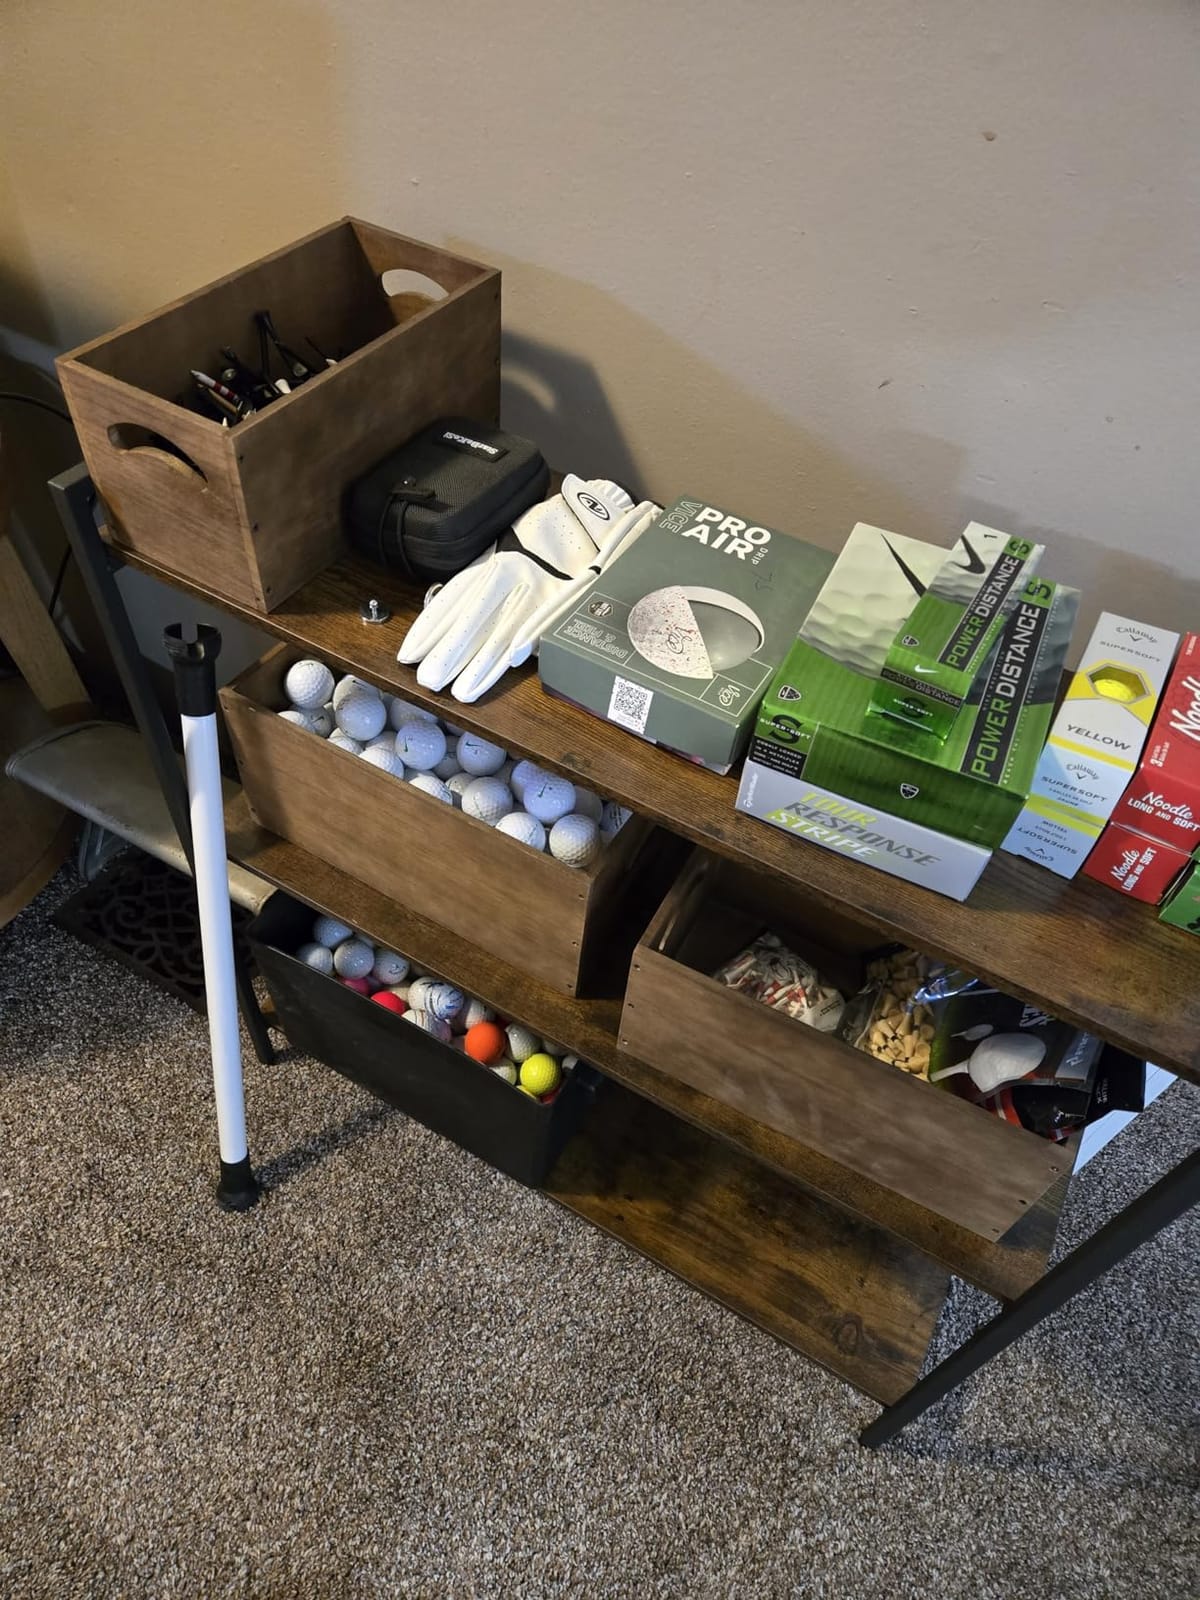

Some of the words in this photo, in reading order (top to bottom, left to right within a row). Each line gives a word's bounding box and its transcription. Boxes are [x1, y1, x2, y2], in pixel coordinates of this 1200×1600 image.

[659, 501, 702, 533] VICE
[695, 507, 771, 545] PRO
[681, 524, 754, 560] AIR
[946, 615, 984, 667] POWER
[974, 556, 1020, 617] DISTANCE
[1100, 641, 1160, 662] SUPERSOFT
[971, 698, 1012, 778] POWER
[995, 604, 1040, 698] DISTANCE
[1066, 723, 1131, 750] YELLOW
[1041, 776, 1108, 801] SUPERSOFT
[1142, 792, 1193, 819] Noodle
[801, 792, 879, 828] TOUR
[1127, 798, 1154, 814] LONG
[1155, 811, 1171, 821] AND
[1173, 817, 1200, 832] SOFT
[772, 812, 879, 857] STRIPE
[784, 802, 941, 866] RESPONSE
[1018, 827, 1078, 855] SUPERSOFT
[1110, 850, 1139, 880] Noodle
